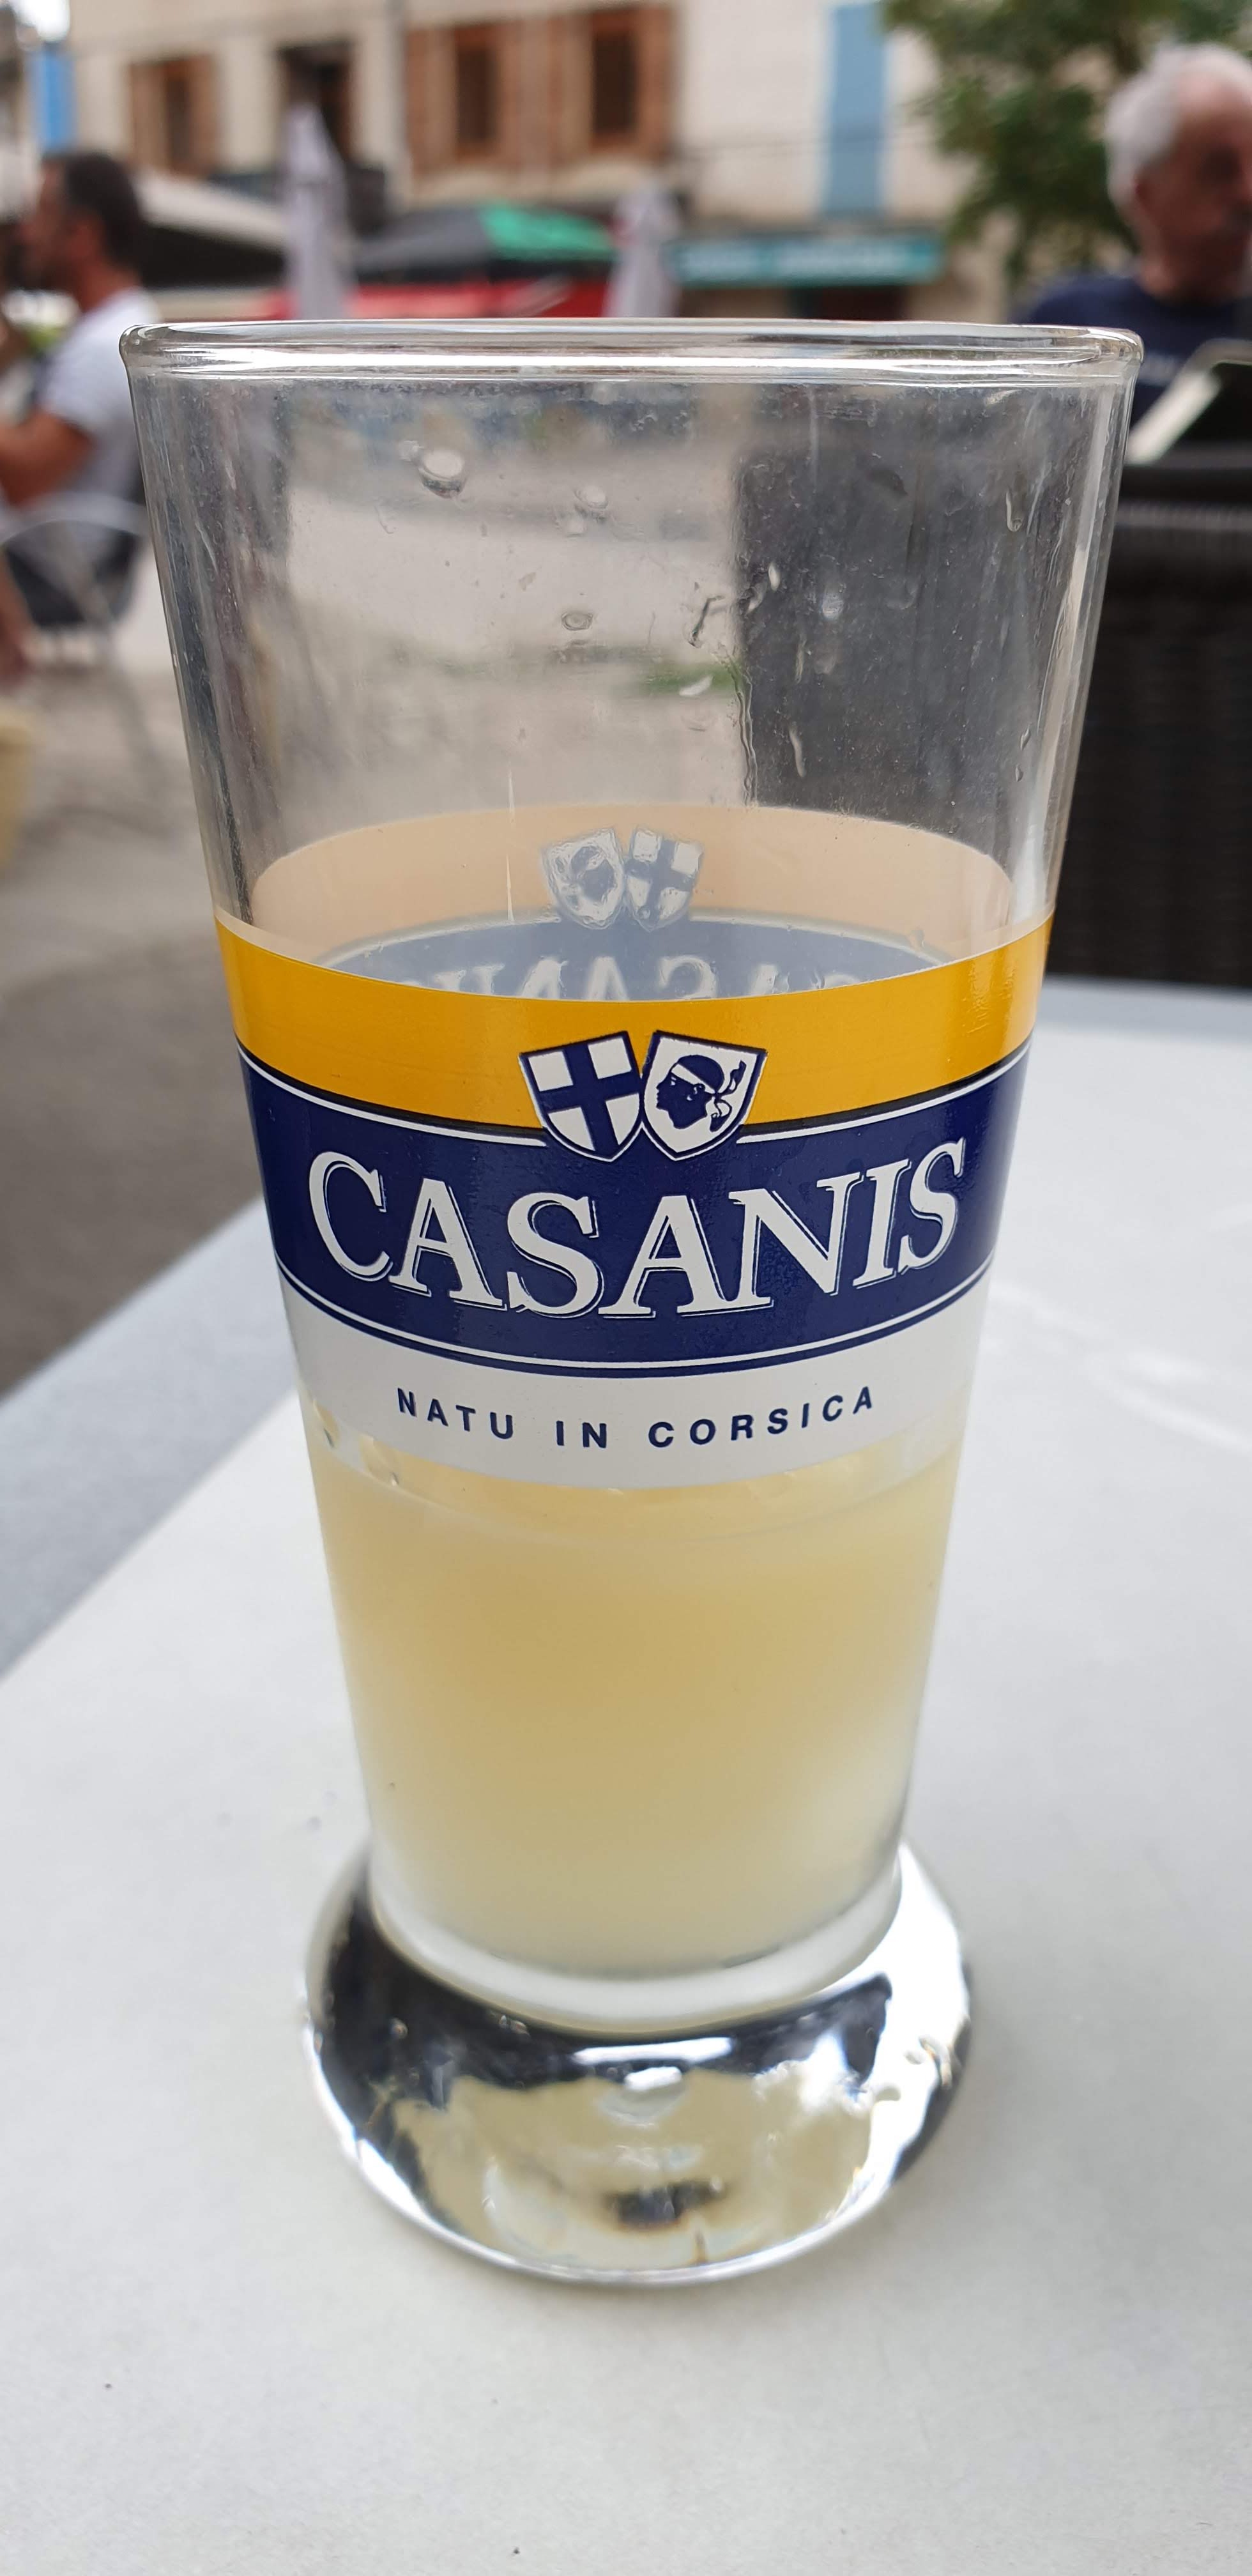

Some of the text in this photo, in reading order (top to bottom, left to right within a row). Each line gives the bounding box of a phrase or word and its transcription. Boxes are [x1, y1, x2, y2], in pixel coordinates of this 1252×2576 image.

[308, 1138, 967, 1319] CASANIS
[396, 1385, 873, 1449] NATU IN CORSICA
